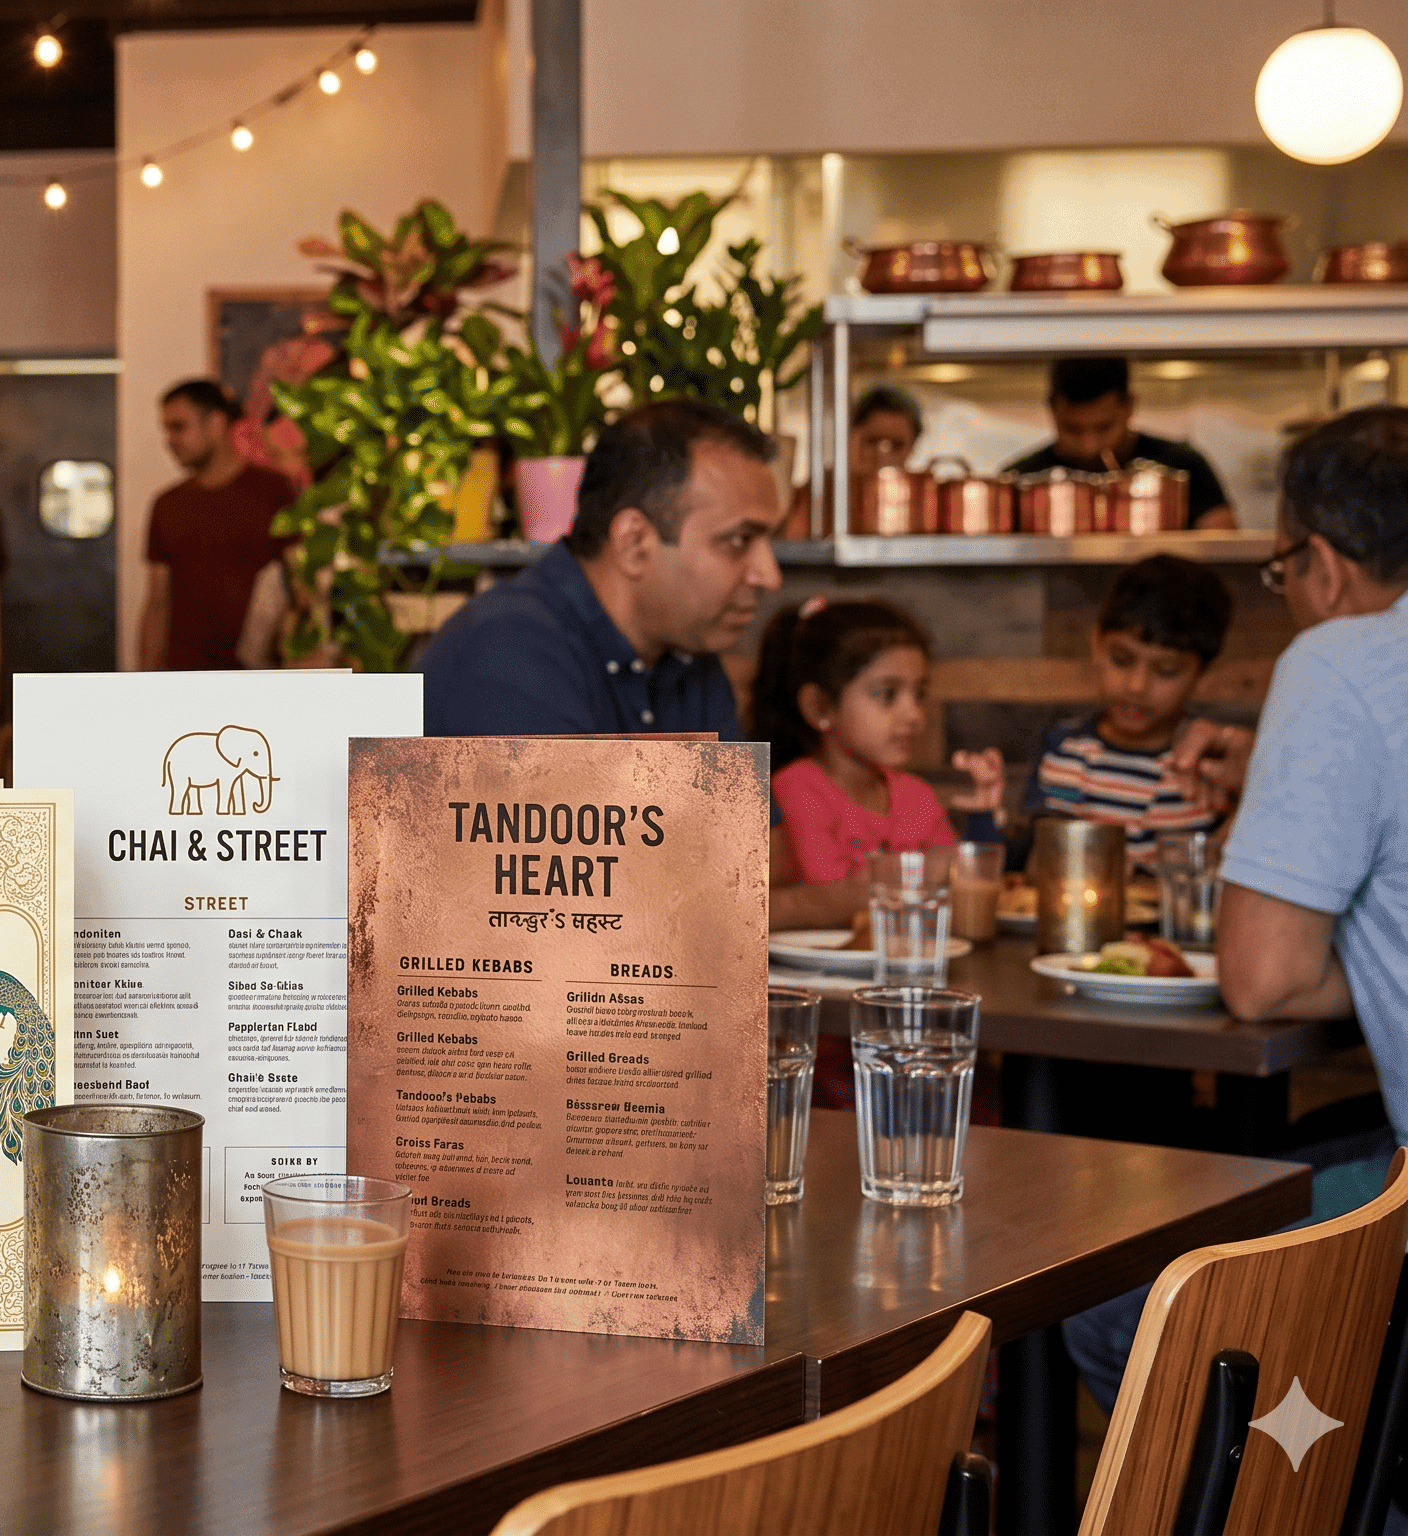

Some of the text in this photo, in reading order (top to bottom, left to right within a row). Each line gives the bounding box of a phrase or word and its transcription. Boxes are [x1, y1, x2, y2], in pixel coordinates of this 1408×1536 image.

[449, 802, 665, 847] TANDOOR’S
[108, 830, 327, 861] CHAI & STREET
[494, 853, 619, 898] HEART
[184, 896, 248, 911] STREET
[74, 929, 121, 939] ndoniten
[228, 929, 303, 939] Dasi & Chaak
[400, 956, 533, 973] GRILLED KEBABS
[397, 985, 478, 998] Grilled Kebabs
[96, 1030, 119, 1039] Suet
[397, 1031, 478, 1045] Grilled Kebabs
[566, 1051, 605, 1063] Grilled
[434, 1138, 464, 1150] Faras
[306, 1157, 318, 1166] BY
